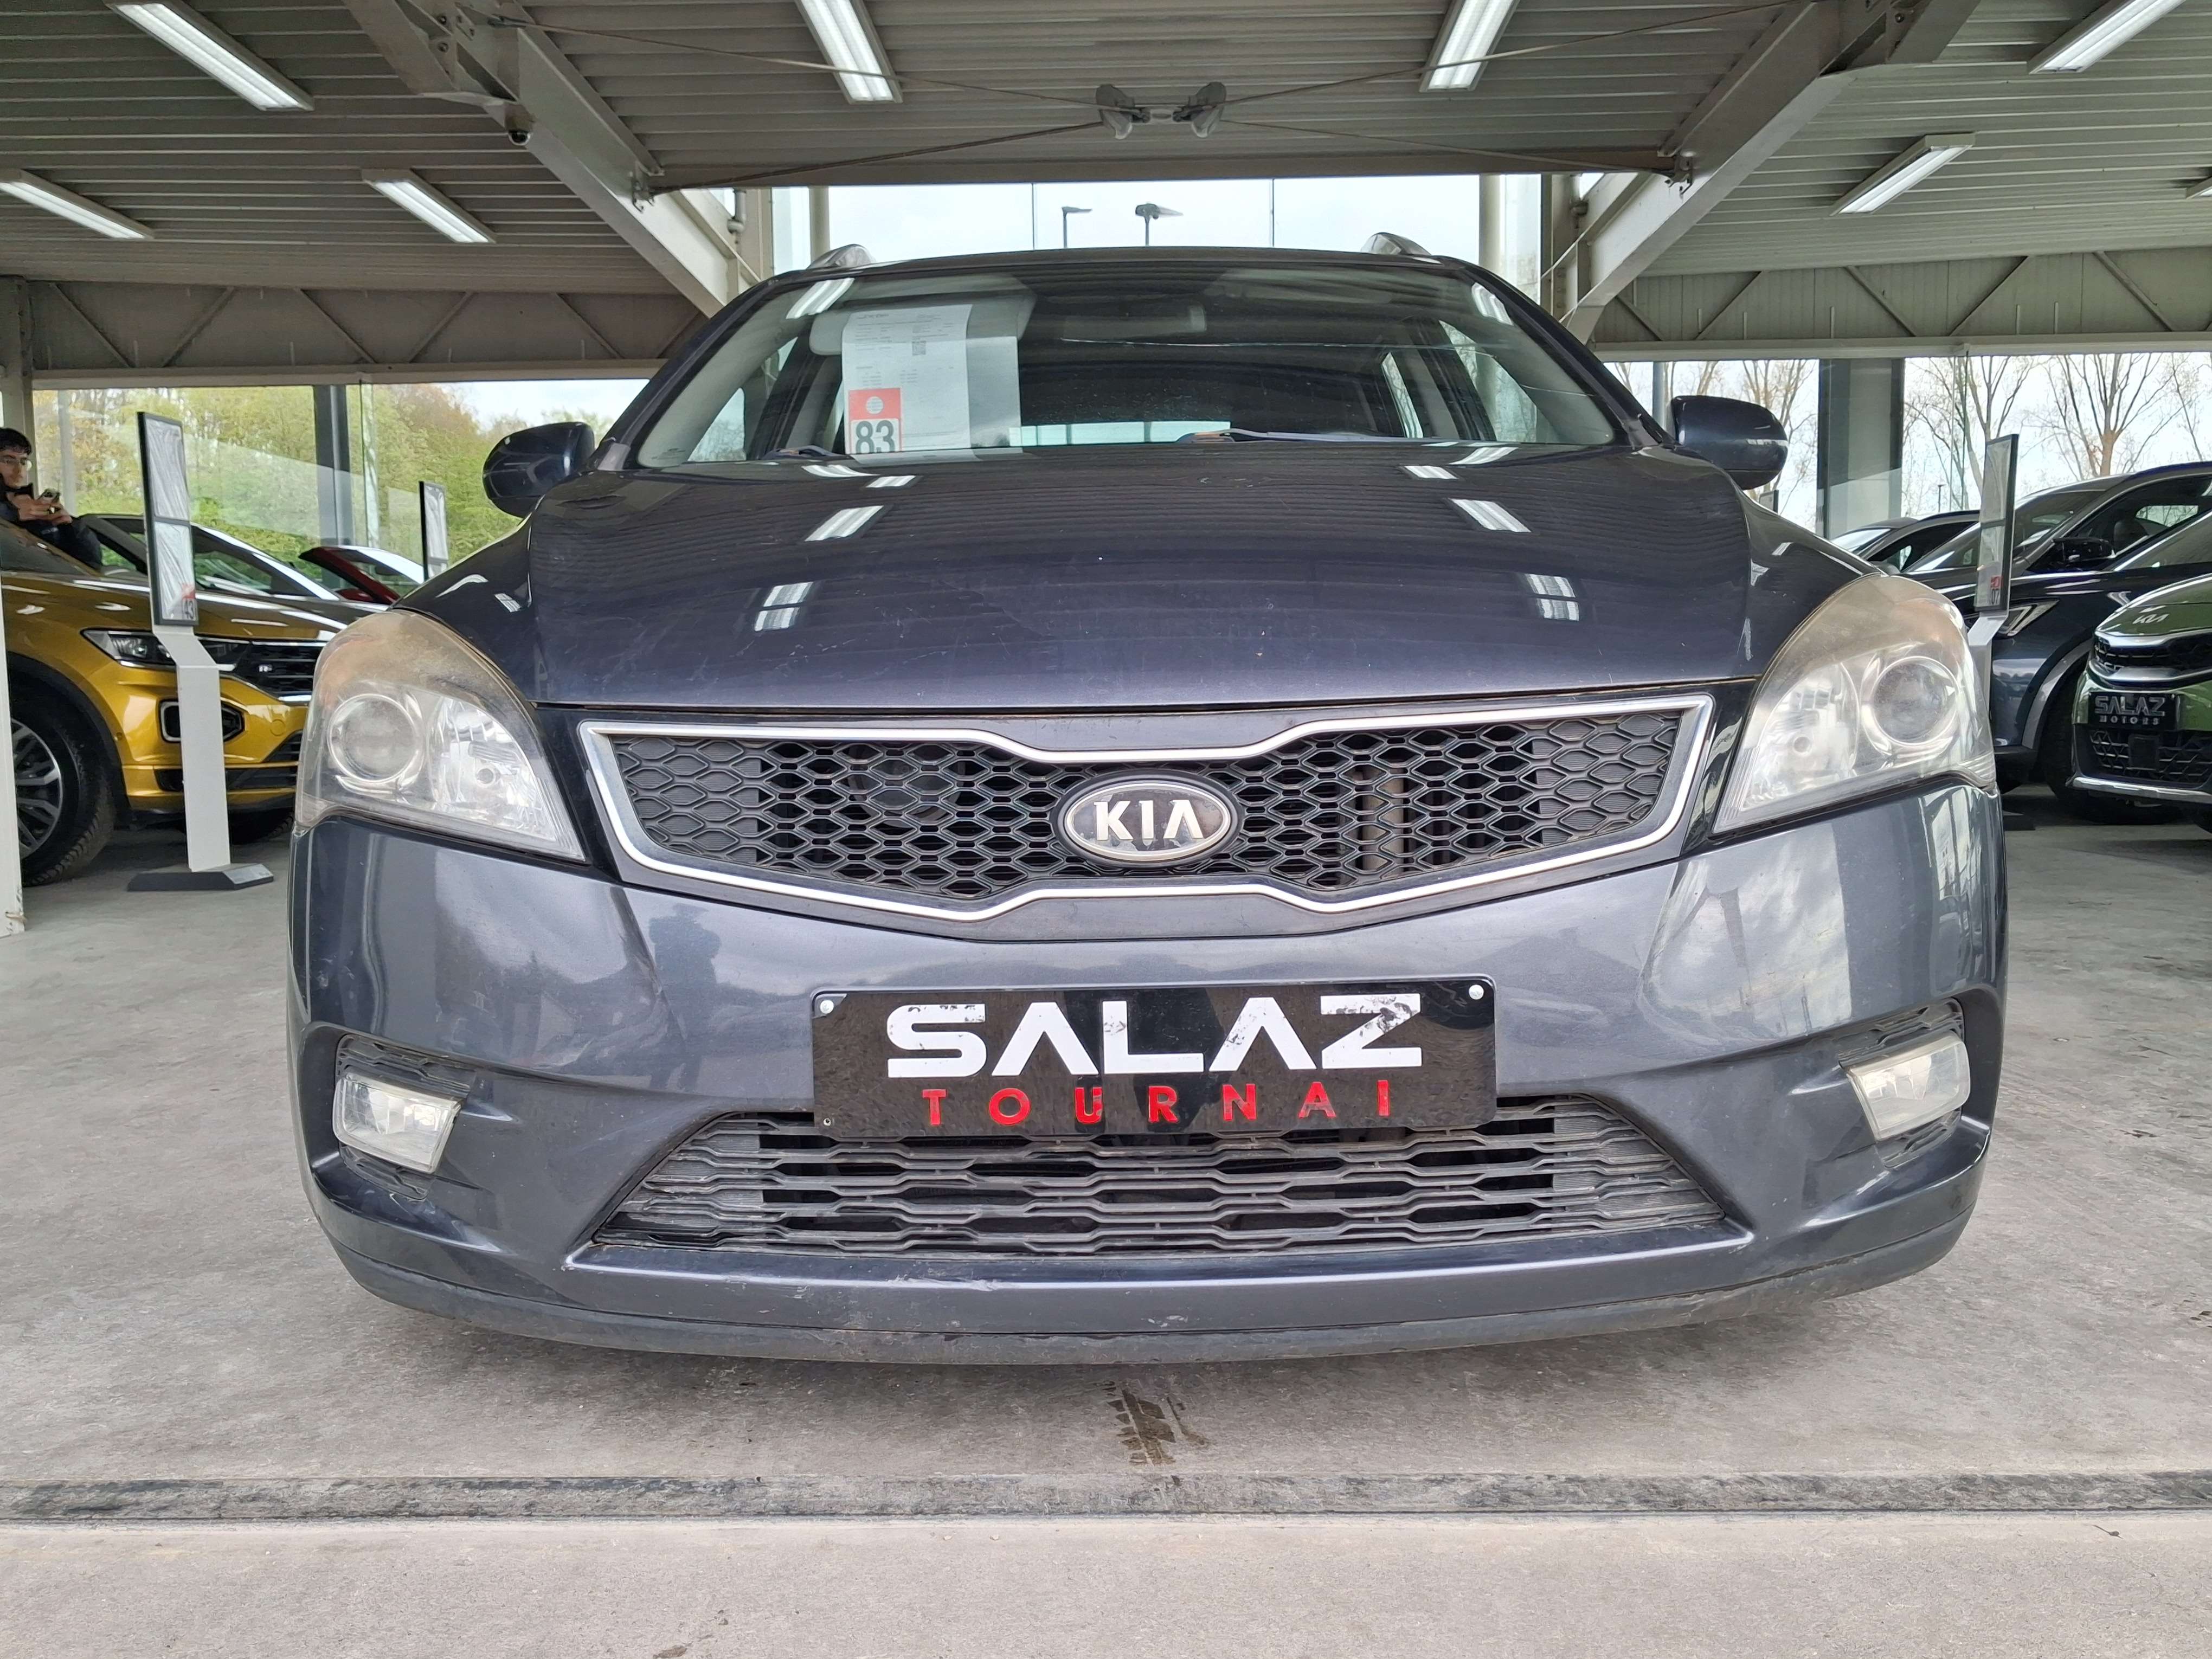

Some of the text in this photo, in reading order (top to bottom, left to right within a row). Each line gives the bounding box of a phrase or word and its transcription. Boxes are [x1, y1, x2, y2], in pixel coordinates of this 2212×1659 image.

[856, 420, 895, 453] 83
[2095, 696, 2165, 717] SALAZ
[2099, 715, 2159, 725] MOTORS
[1094, 799, 1204, 841] KIA
[886, 993, 1423, 1078] SALAZ
[922, 1079, 1391, 1126] TOURNAI
